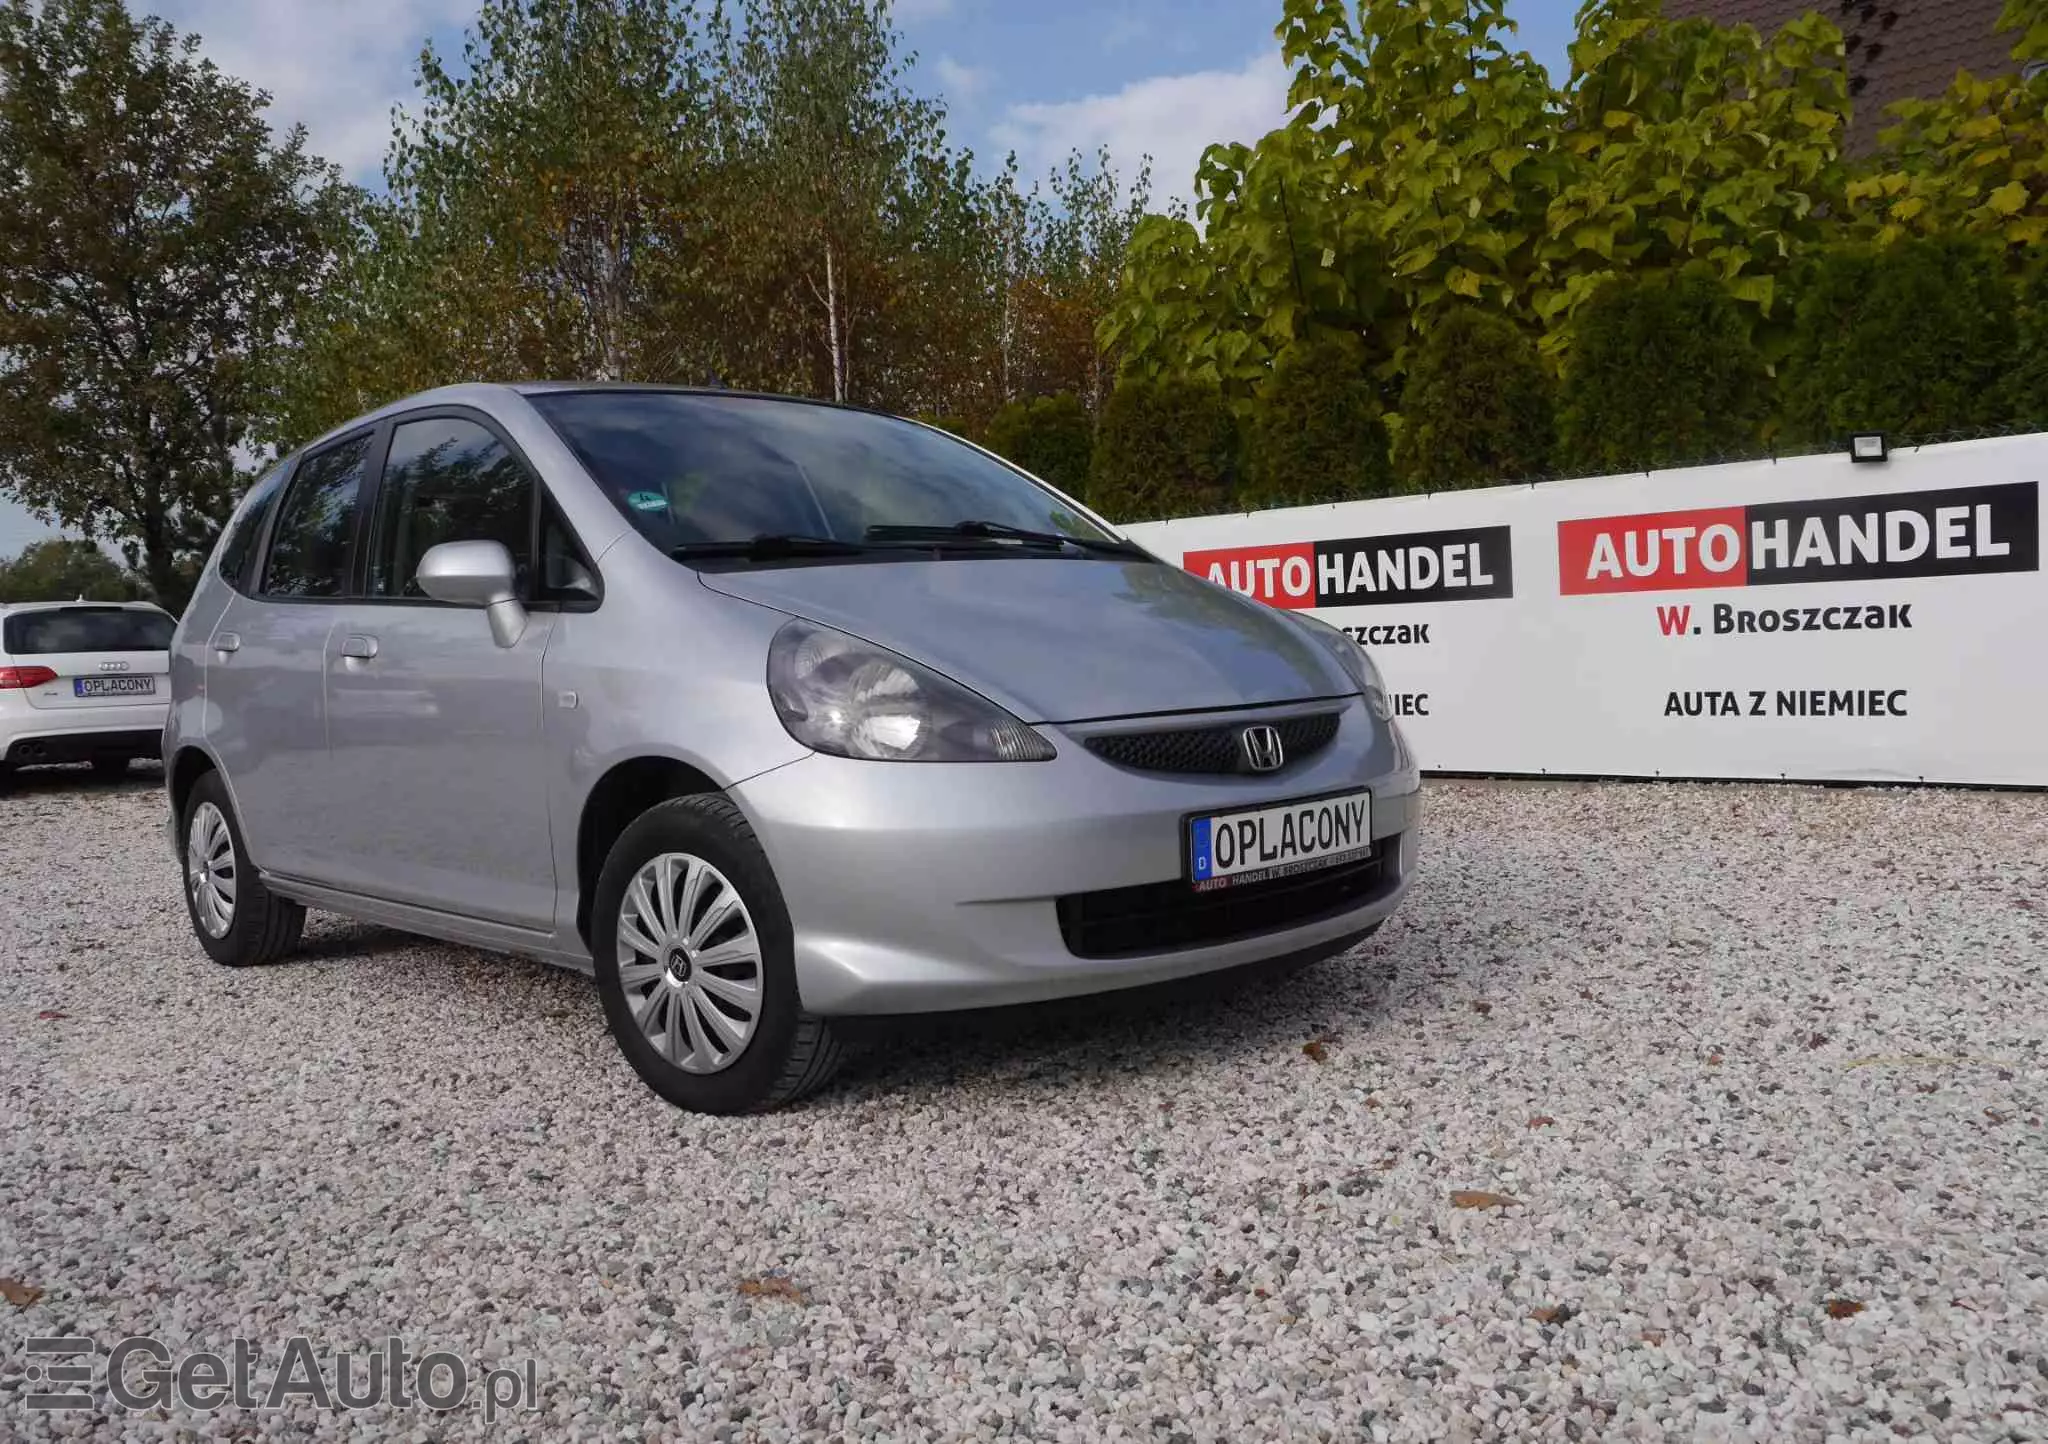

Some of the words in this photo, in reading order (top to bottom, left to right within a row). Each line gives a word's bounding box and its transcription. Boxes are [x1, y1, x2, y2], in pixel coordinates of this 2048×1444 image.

[1656, 604, 1702, 636] W.
[1663, 691, 1741, 717] AUTA
[1748, 691, 1767, 716] Z
[1776, 690, 1908, 717] NIEMIEC
[1215, 800, 1366, 869] OPLACONY
[1199, 877, 1227, 892] AUTO
